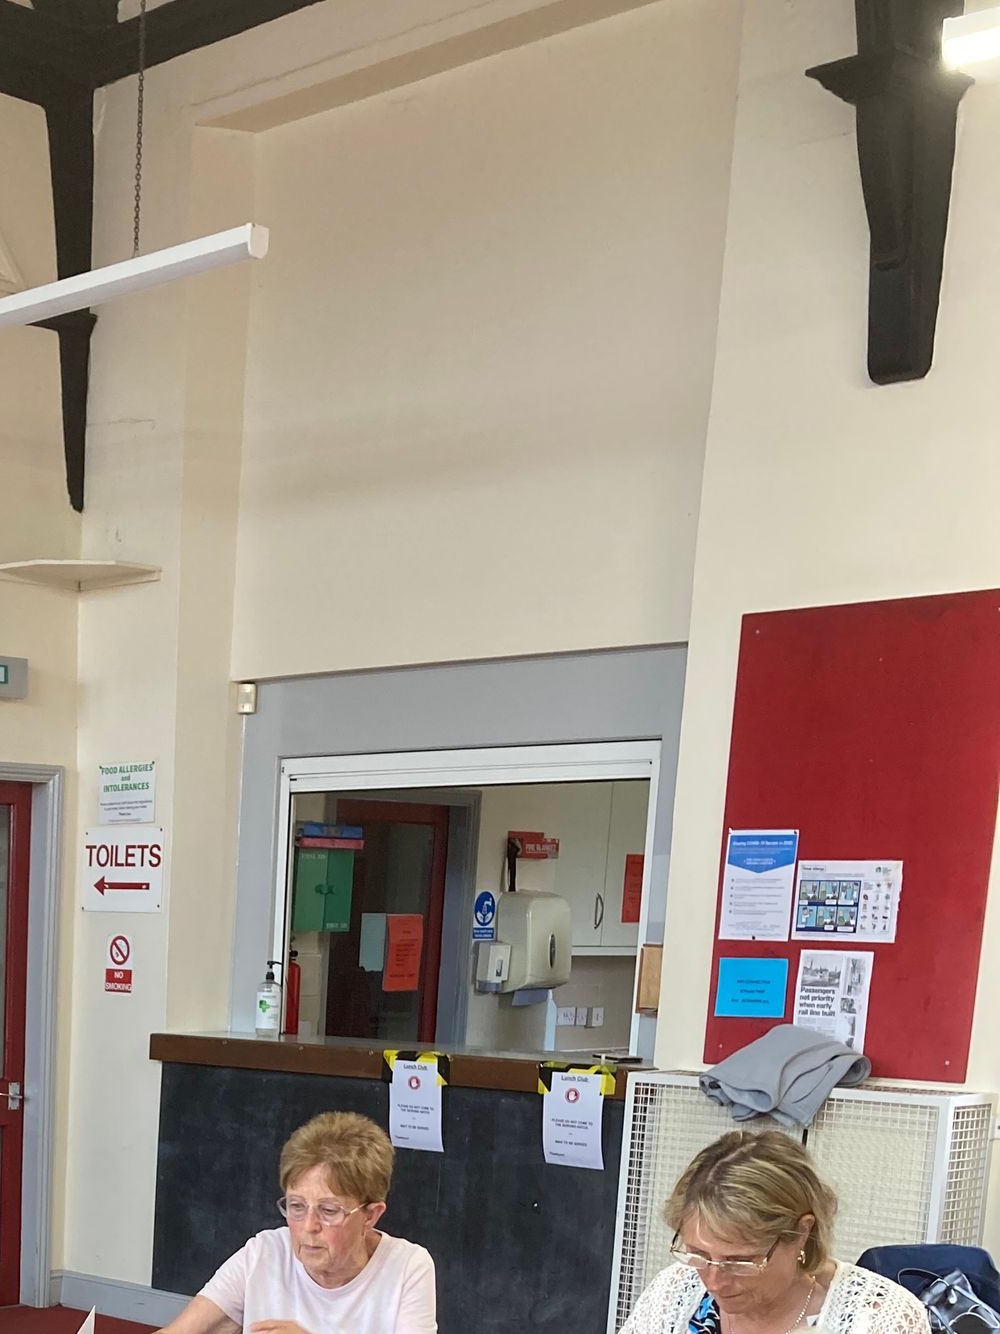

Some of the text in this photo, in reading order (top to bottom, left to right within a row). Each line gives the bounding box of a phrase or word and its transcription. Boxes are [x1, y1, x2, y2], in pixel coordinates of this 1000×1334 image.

[101, 764, 153, 775] FOOD ALLERGIES
[121, 773, 131, 781] and
[103, 782, 149, 792] INTOLERANCES
[85, 844, 161, 868] TOILETS
[114, 971, 124, 979] NO
[104, 982, 132, 991] SMOKING
[800, 986, 835, 994] Passengers
[811, 995, 835, 1003] priority
